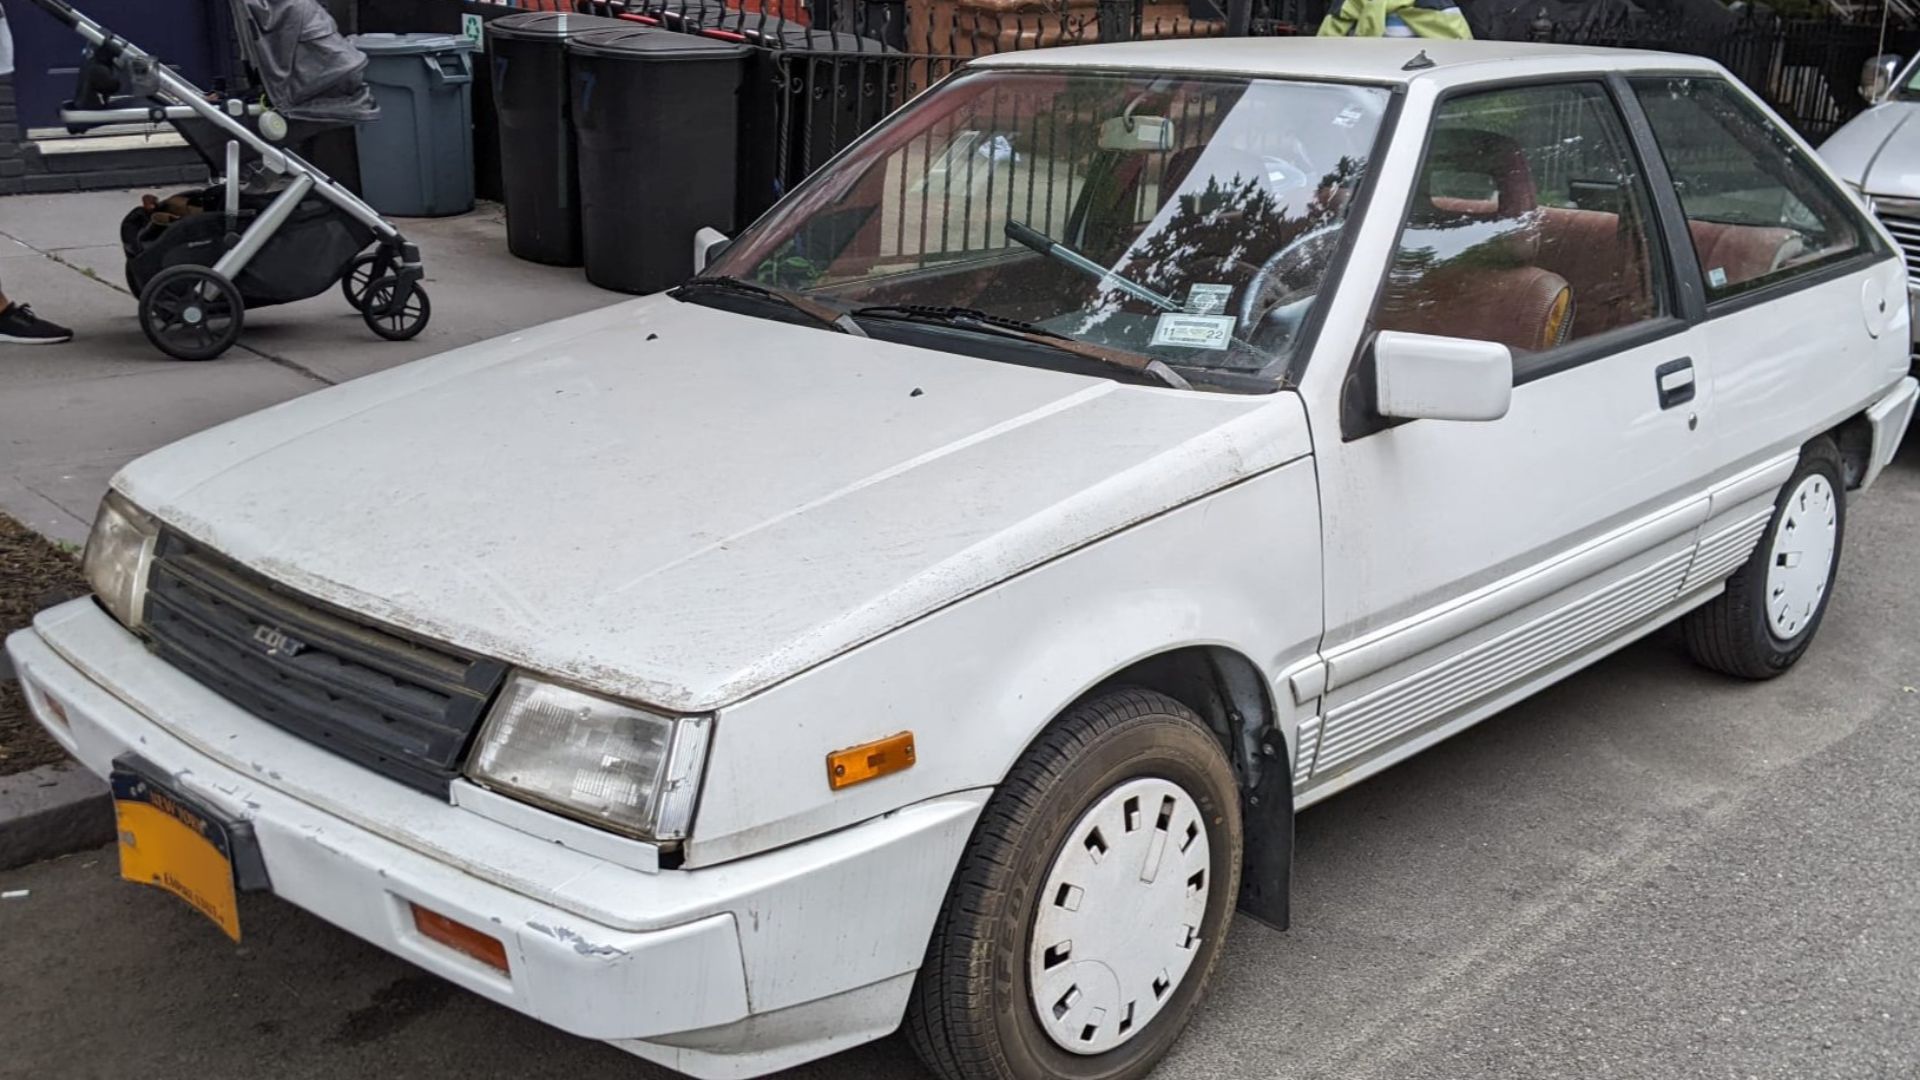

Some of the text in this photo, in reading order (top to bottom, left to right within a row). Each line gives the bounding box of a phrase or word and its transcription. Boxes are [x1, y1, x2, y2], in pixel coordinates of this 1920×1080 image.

[576, 72, 596, 112] 7
[1163, 327, 1176, 337] 11
[1205, 330, 1224, 340] 22
